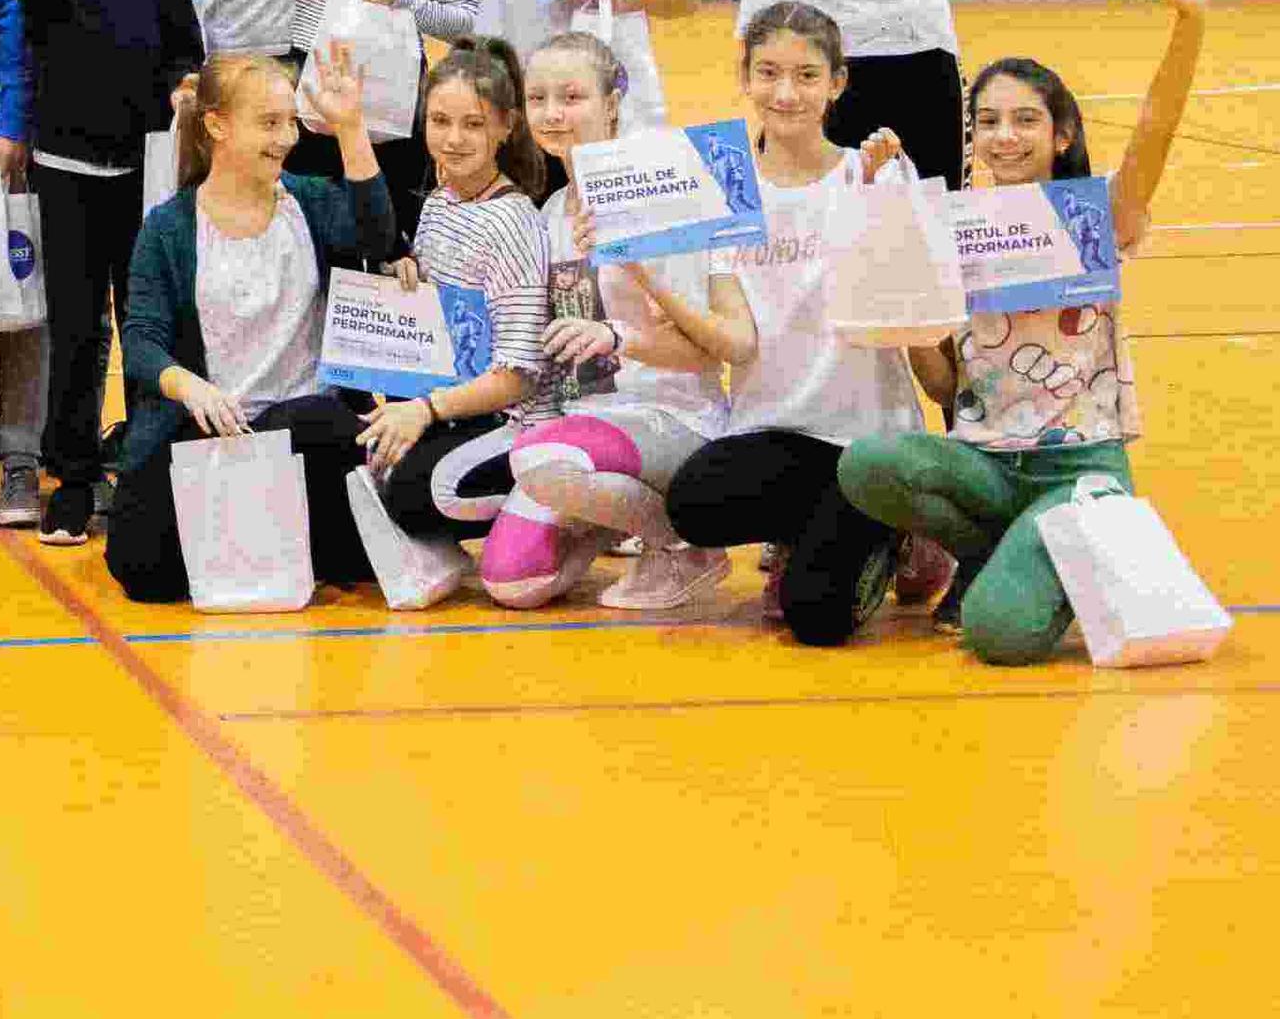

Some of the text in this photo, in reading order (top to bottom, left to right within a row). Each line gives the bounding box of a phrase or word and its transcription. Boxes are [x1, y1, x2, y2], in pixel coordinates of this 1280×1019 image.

[585, 167, 677, 192] SPORTUL DE
[955, 223, 1030, 242] ORTUL DE
[332, 304, 417, 328] SPORTUL DE
